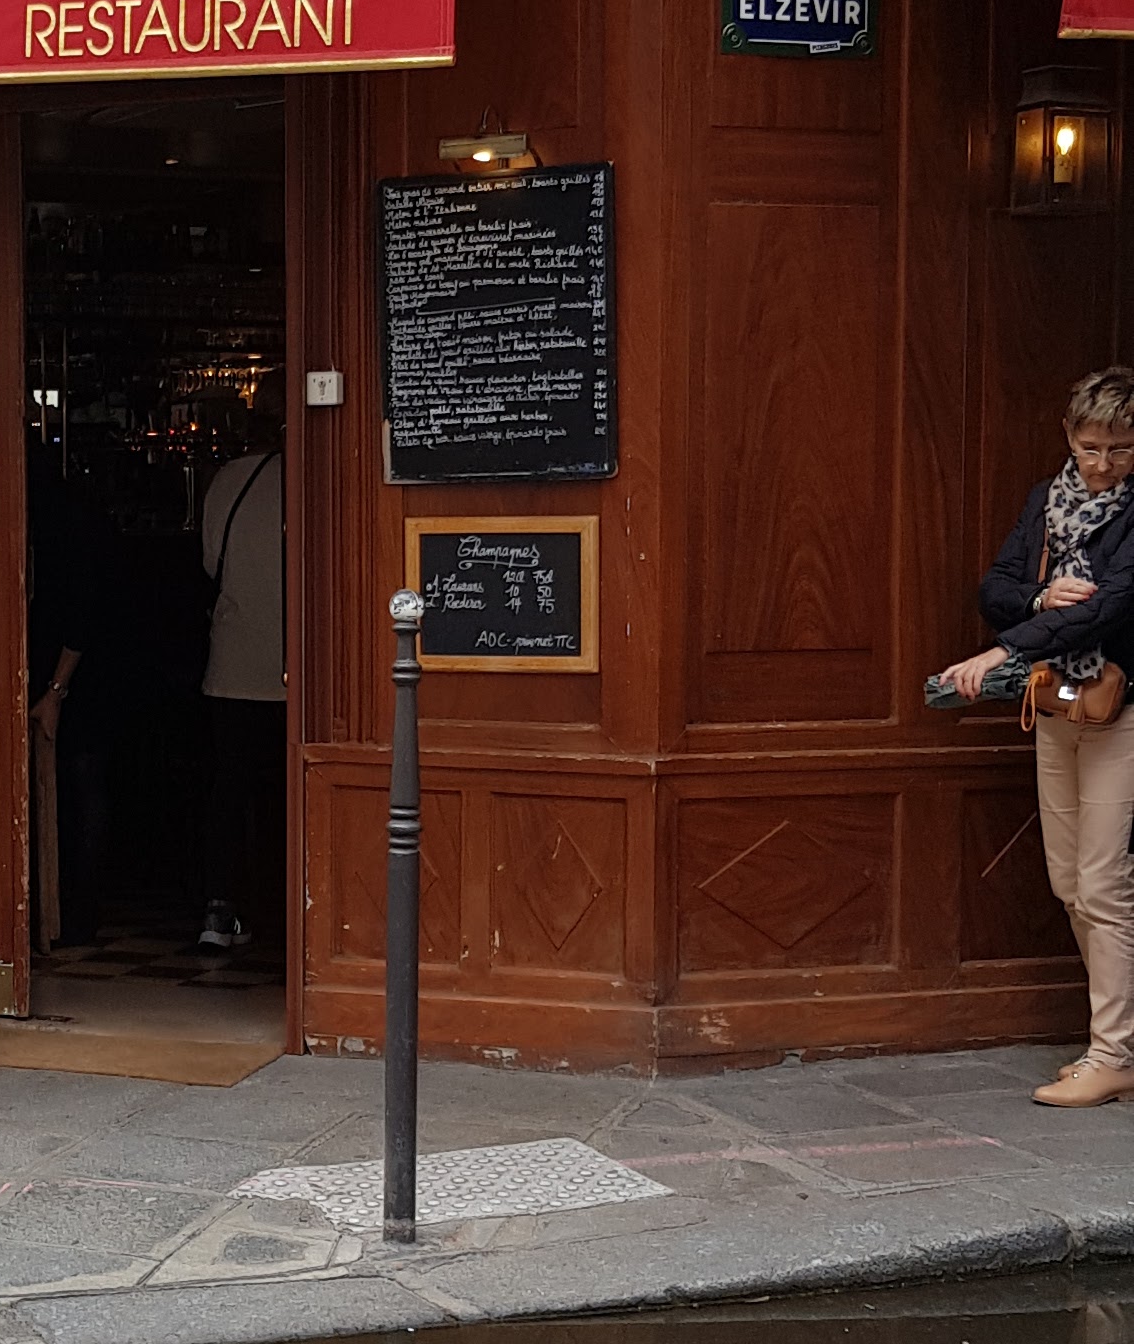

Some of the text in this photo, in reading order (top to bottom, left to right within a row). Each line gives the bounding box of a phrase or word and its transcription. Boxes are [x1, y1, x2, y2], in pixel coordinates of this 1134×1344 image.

[457, 535, 540, 569] Champagnes
[505, 584, 520, 598] 10
[537, 586, 552, 599] 50
[537, 598, 555, 614] 75
